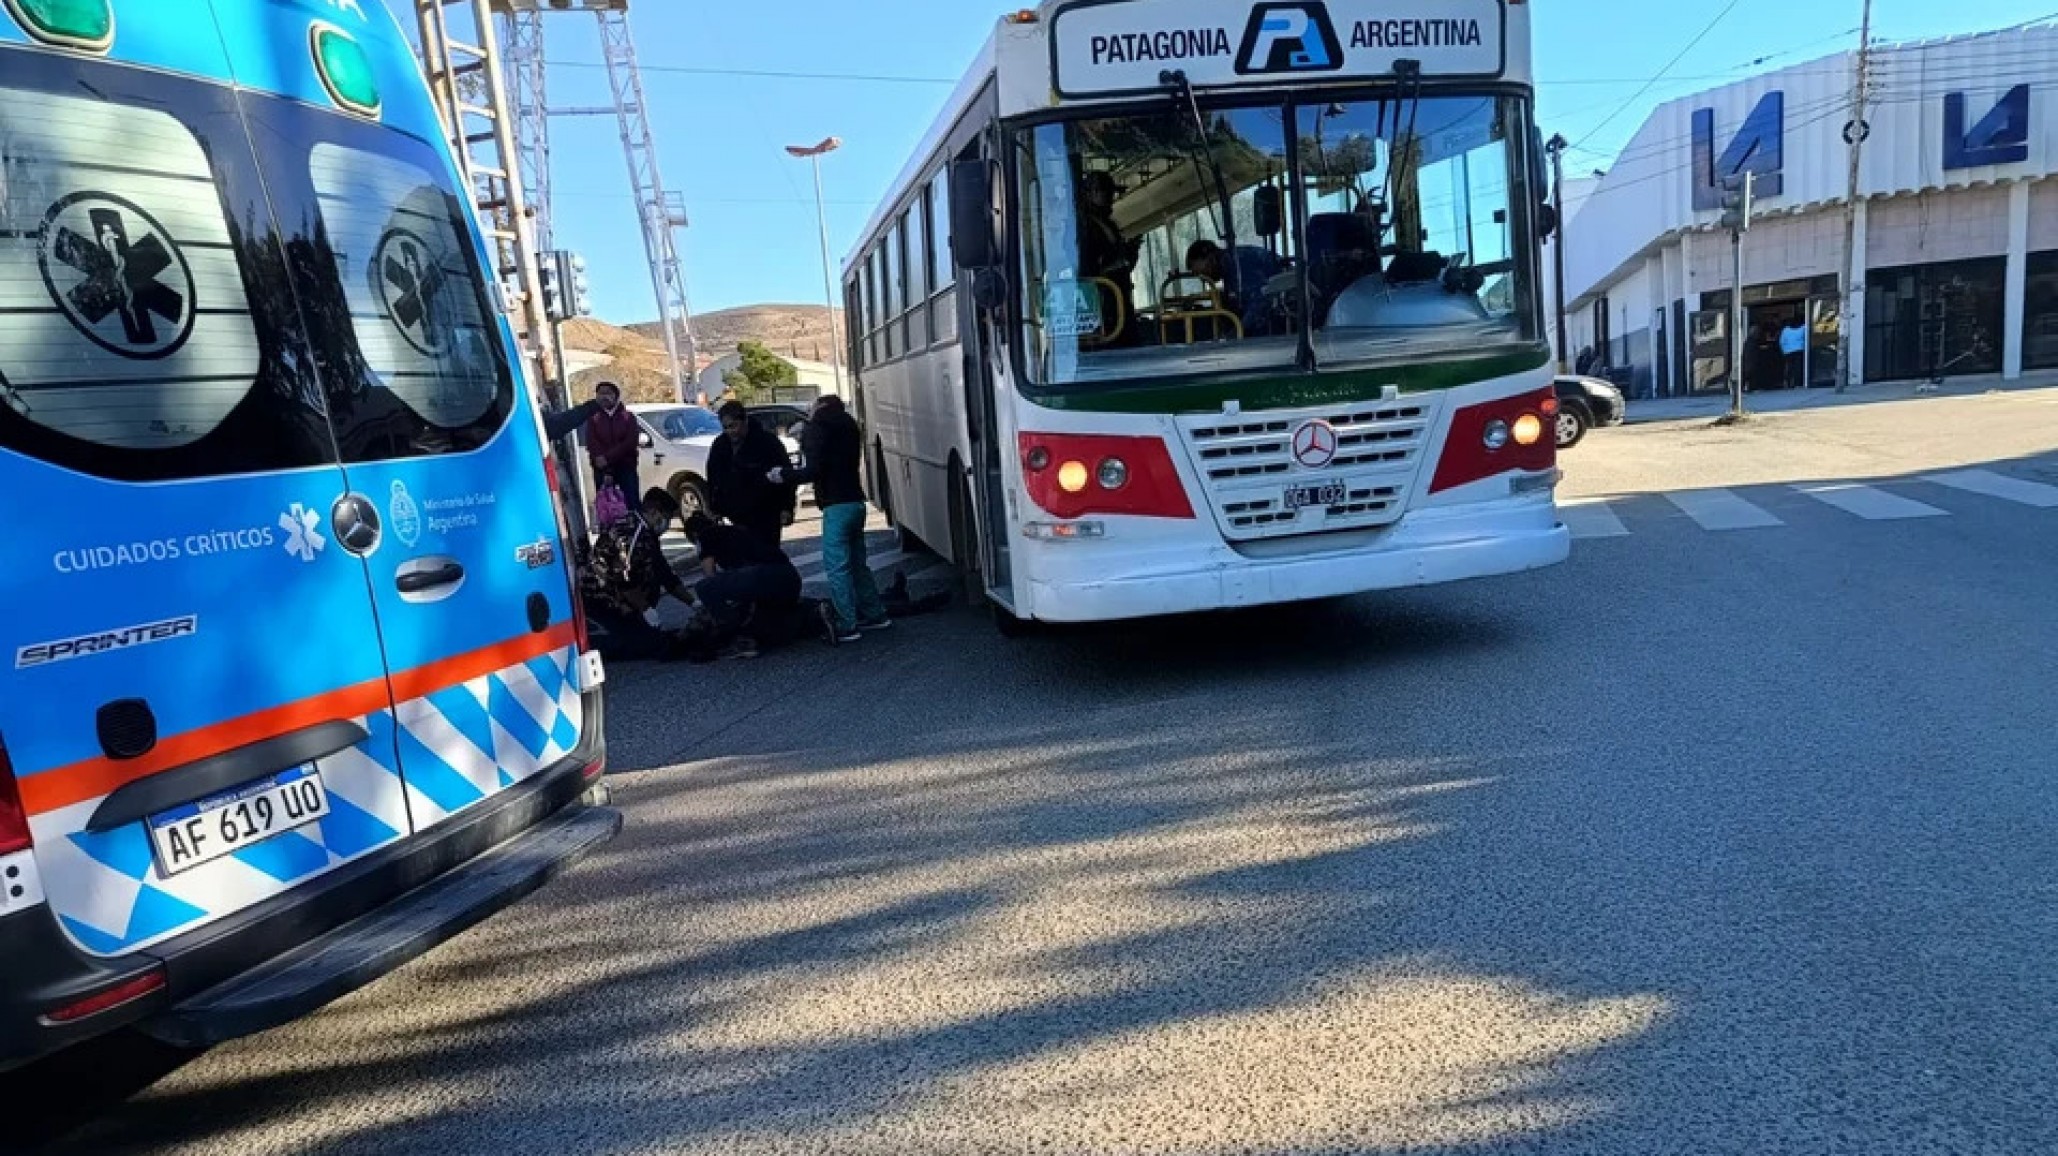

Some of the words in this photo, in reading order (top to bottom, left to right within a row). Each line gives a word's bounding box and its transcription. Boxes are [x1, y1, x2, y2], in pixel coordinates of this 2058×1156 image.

[1091, 27, 1231, 65] PATAGONIA
[1350, 18, 1481, 49] ARGENTINA
[429, 512, 478, 534] Argentina
[53, 537, 181, 573] CUIDADOS
[184, 527, 273, 556] CRÍTICOS
[18, 616, 195, 668] SPRINTER
[168, 816, 207, 863] AF
[220, 795, 273, 843] 619
